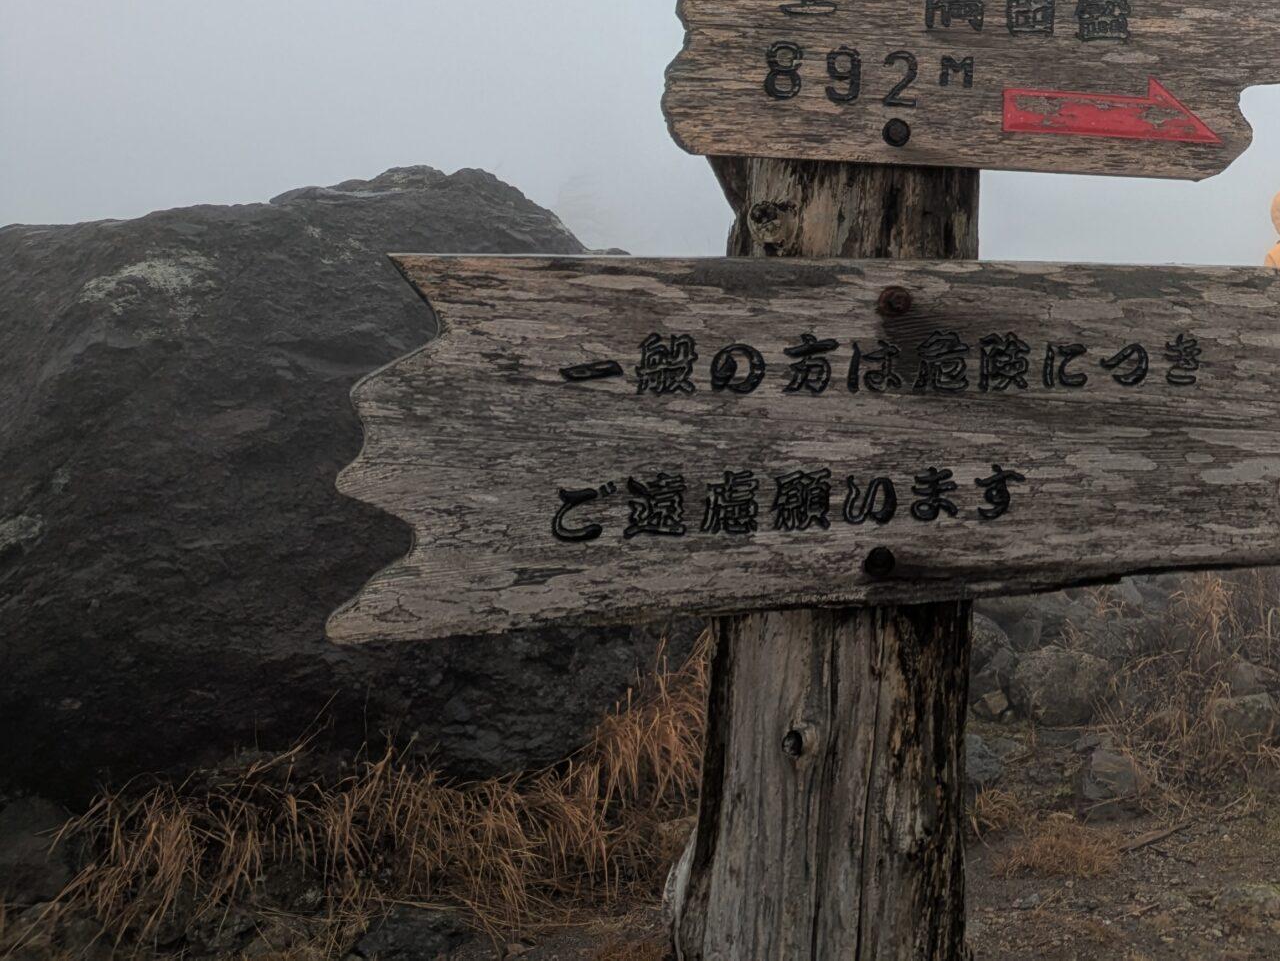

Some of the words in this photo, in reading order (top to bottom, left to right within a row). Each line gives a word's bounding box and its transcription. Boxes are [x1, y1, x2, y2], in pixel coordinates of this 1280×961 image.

[559, 331, 1202, 396] 一般の方は危険につき
[551, 464, 1025, 541] ご遠慮願います
